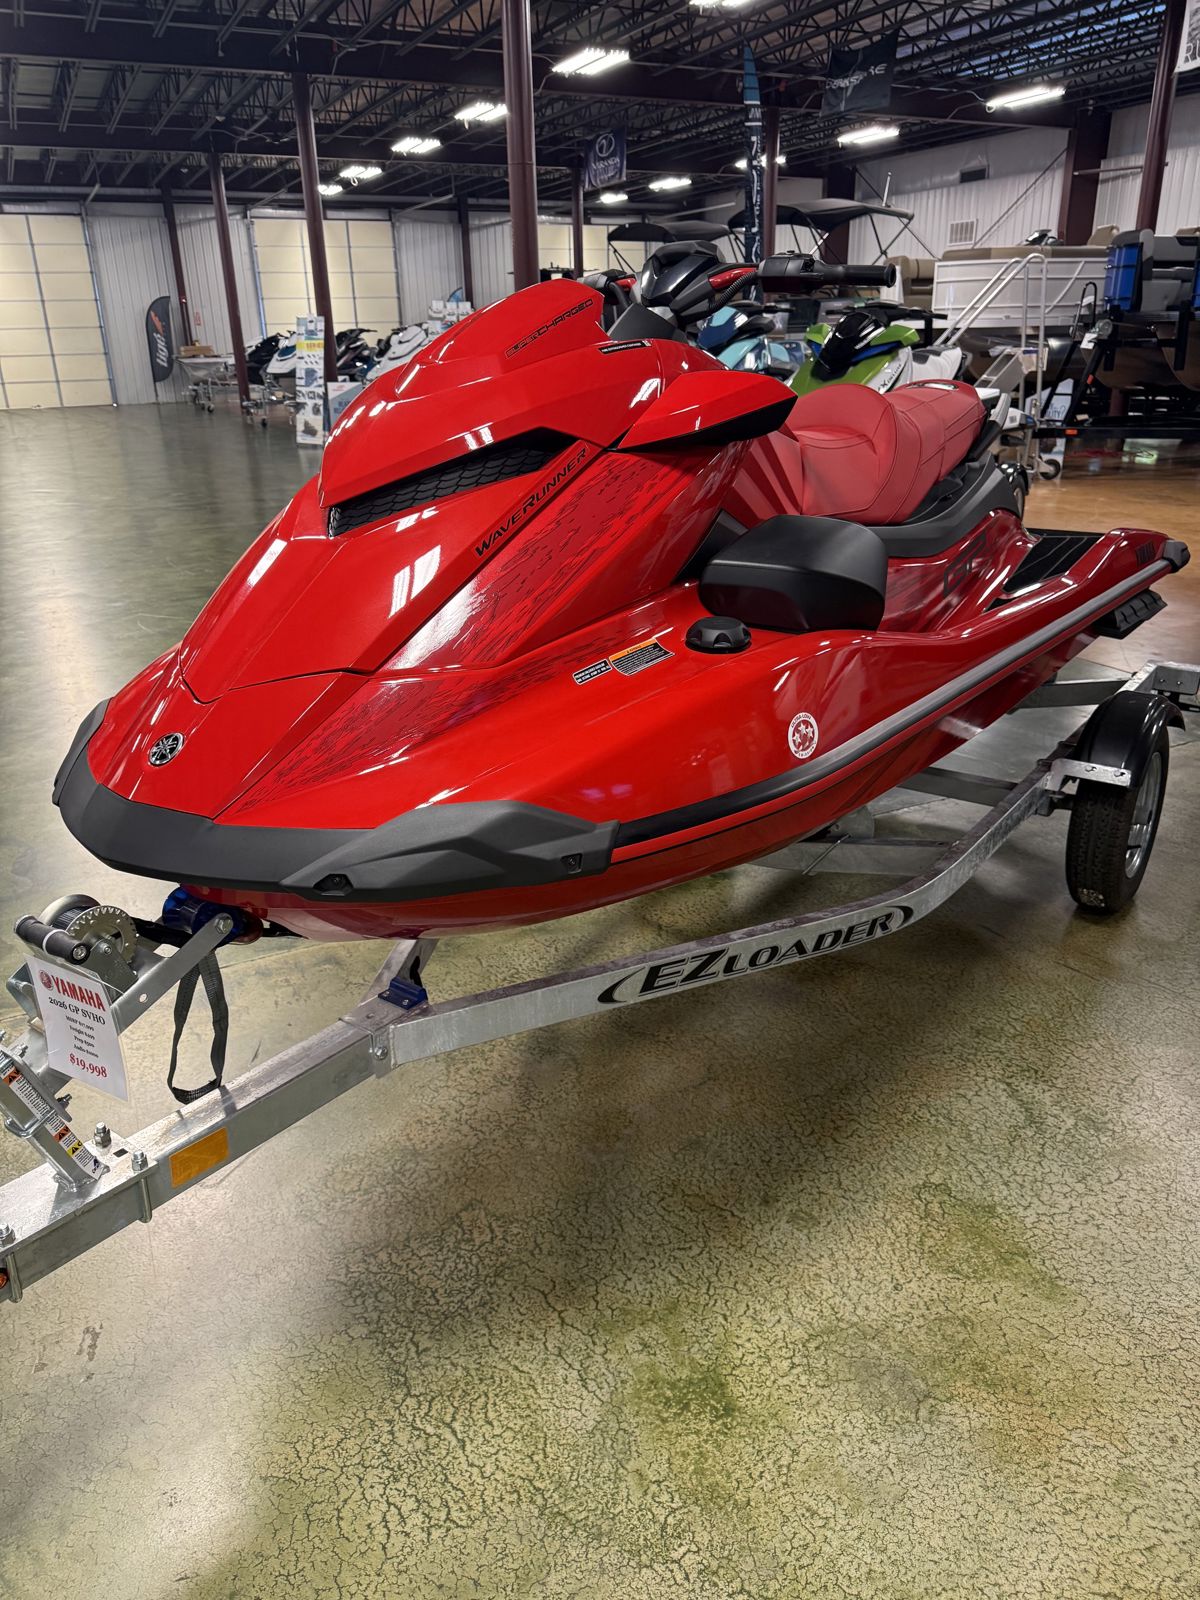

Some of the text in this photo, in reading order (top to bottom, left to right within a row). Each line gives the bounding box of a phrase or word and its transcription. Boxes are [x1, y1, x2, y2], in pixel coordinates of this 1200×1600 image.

[51, 974, 106, 1012] YAMAHA
[48, 996, 106, 1025] 2026 GP SVHO
[69, 1053, 108, 1078] $19,998
